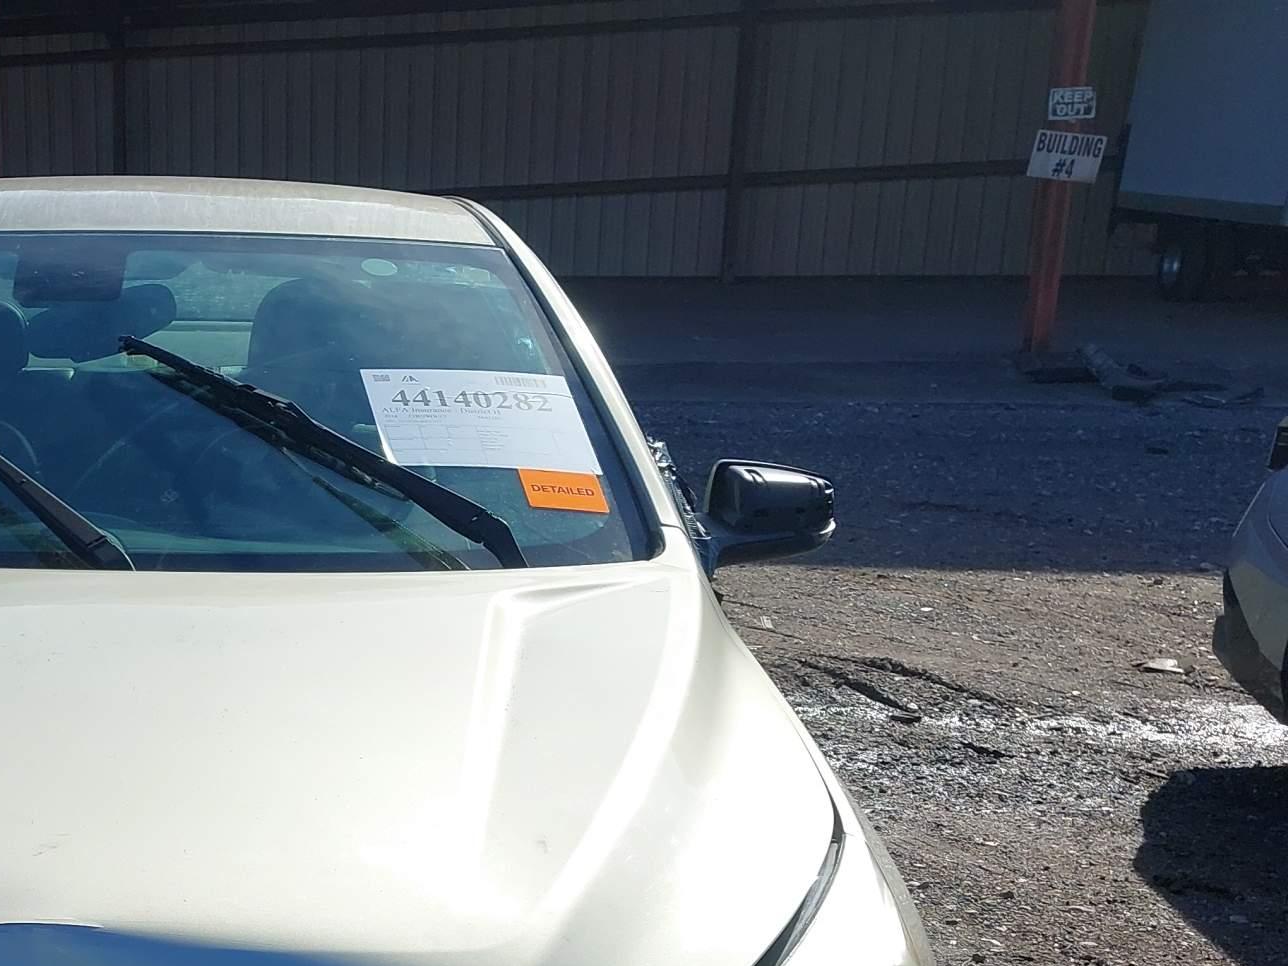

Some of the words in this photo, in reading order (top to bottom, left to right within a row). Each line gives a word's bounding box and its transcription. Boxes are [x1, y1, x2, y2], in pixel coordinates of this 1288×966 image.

[1052, 90, 1094, 103] KEEP
[1055, 103, 1089, 116] OUT
[1036, 132, 1104, 159] BUILDING
[1051, 158, 1076, 178] #4
[391, 389, 552, 412] 44140282
[531, 484, 595, 496] DETAILED
